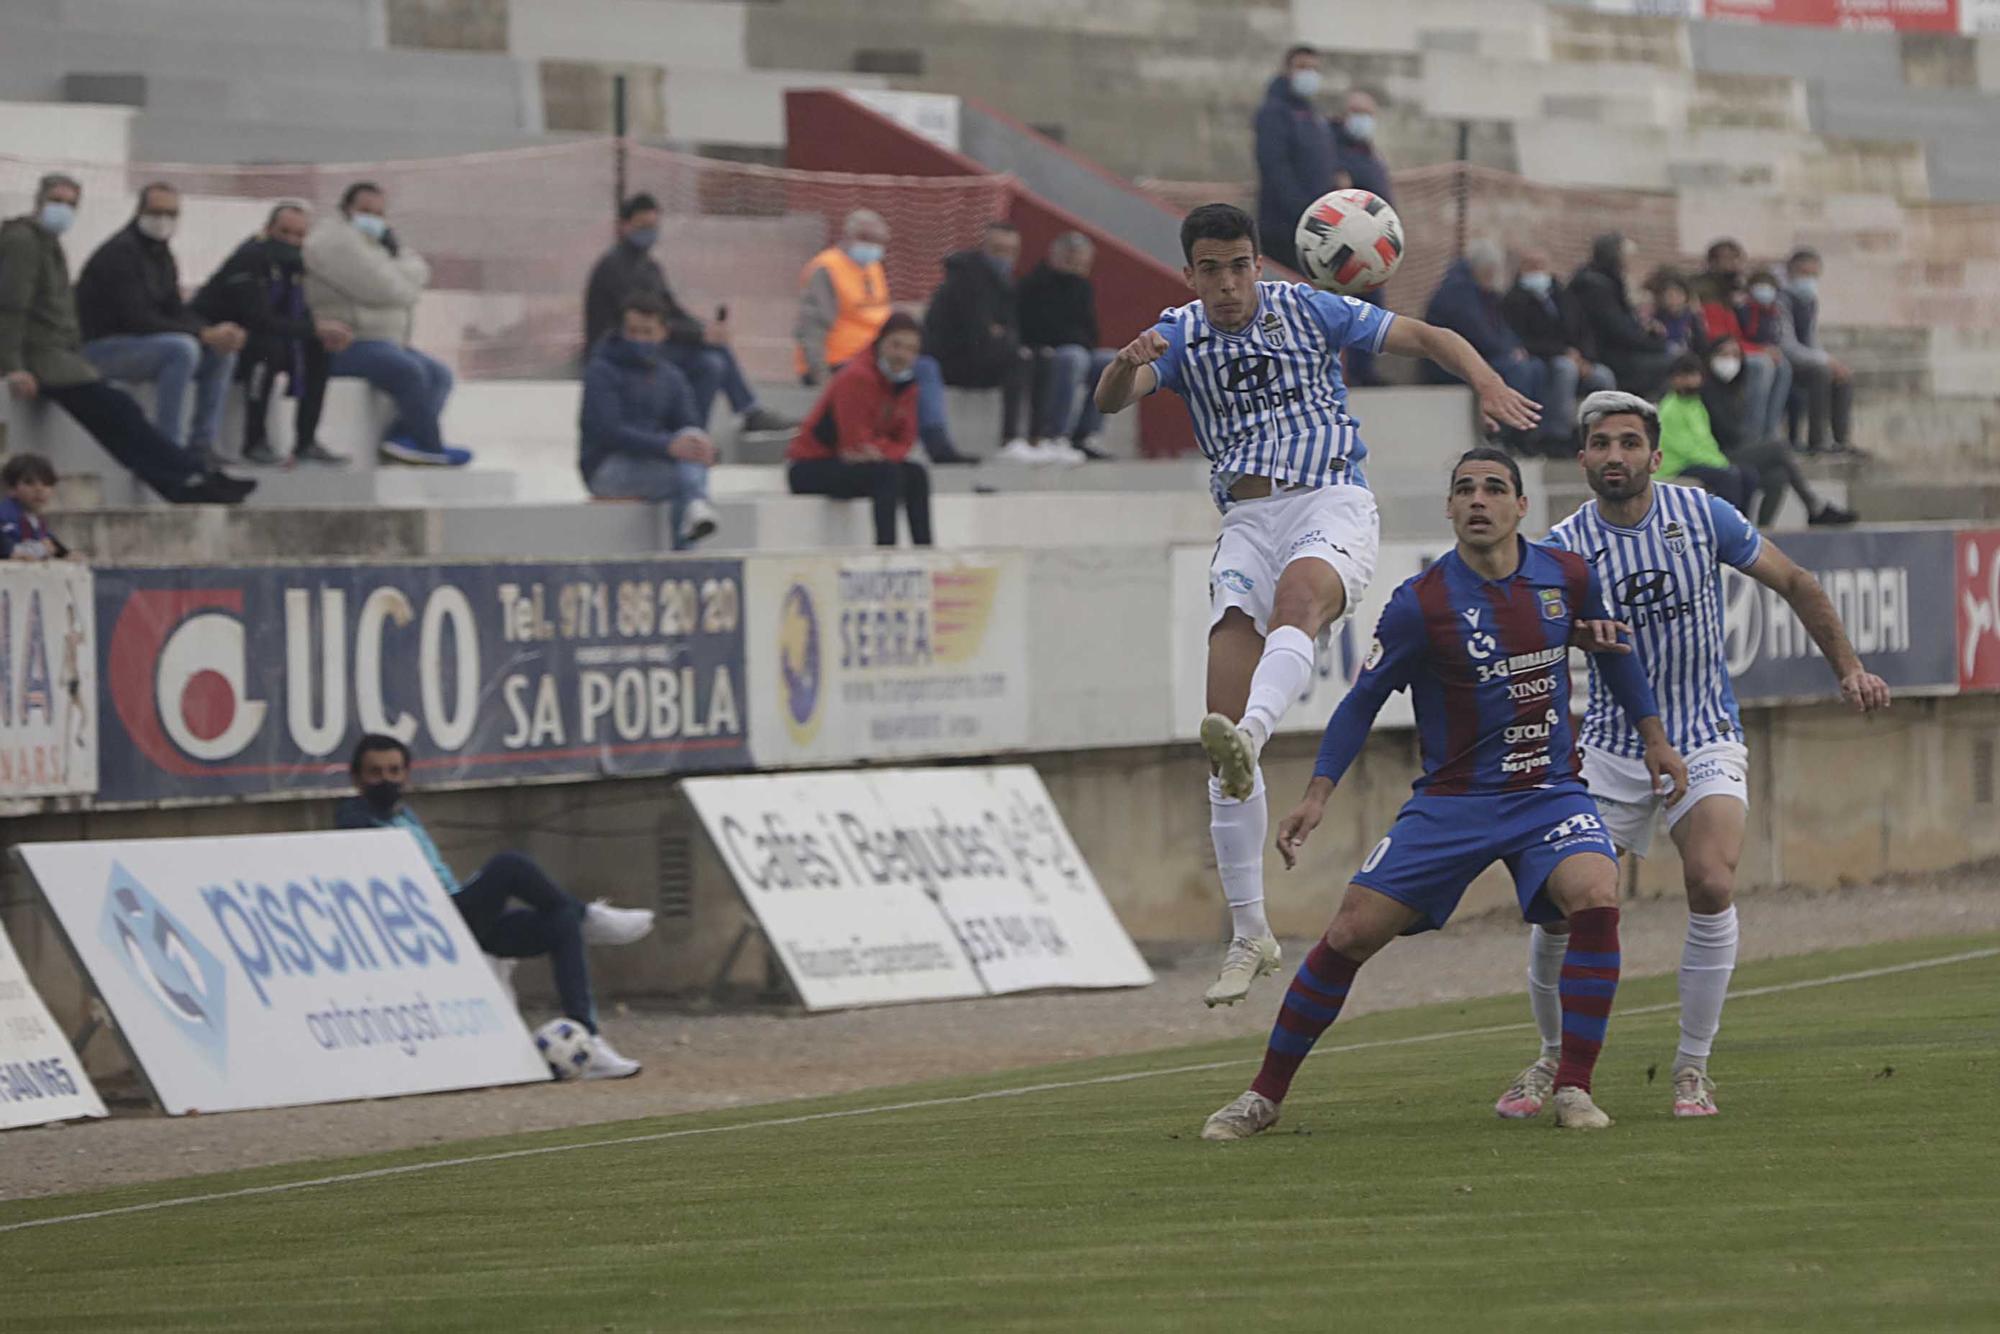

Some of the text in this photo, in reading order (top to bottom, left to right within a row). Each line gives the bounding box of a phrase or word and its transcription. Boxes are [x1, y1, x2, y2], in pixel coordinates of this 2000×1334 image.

[499, 582, 555, 641] Tel.
[558, 581, 609, 639] 971
[659, 578, 698, 636] 20
[701, 577, 739, 633] 20
[841, 608, 933, 669] SERRA
[284, 584, 480, 757] UCO
[1476, 660, 1510, 682] 3-G
[503, 664, 740, 749] SA POBLA
[1503, 722, 1551, 744] grau
[1501, 754, 1552, 773] MAJOR
[198, 875, 459, 1009] piscines
